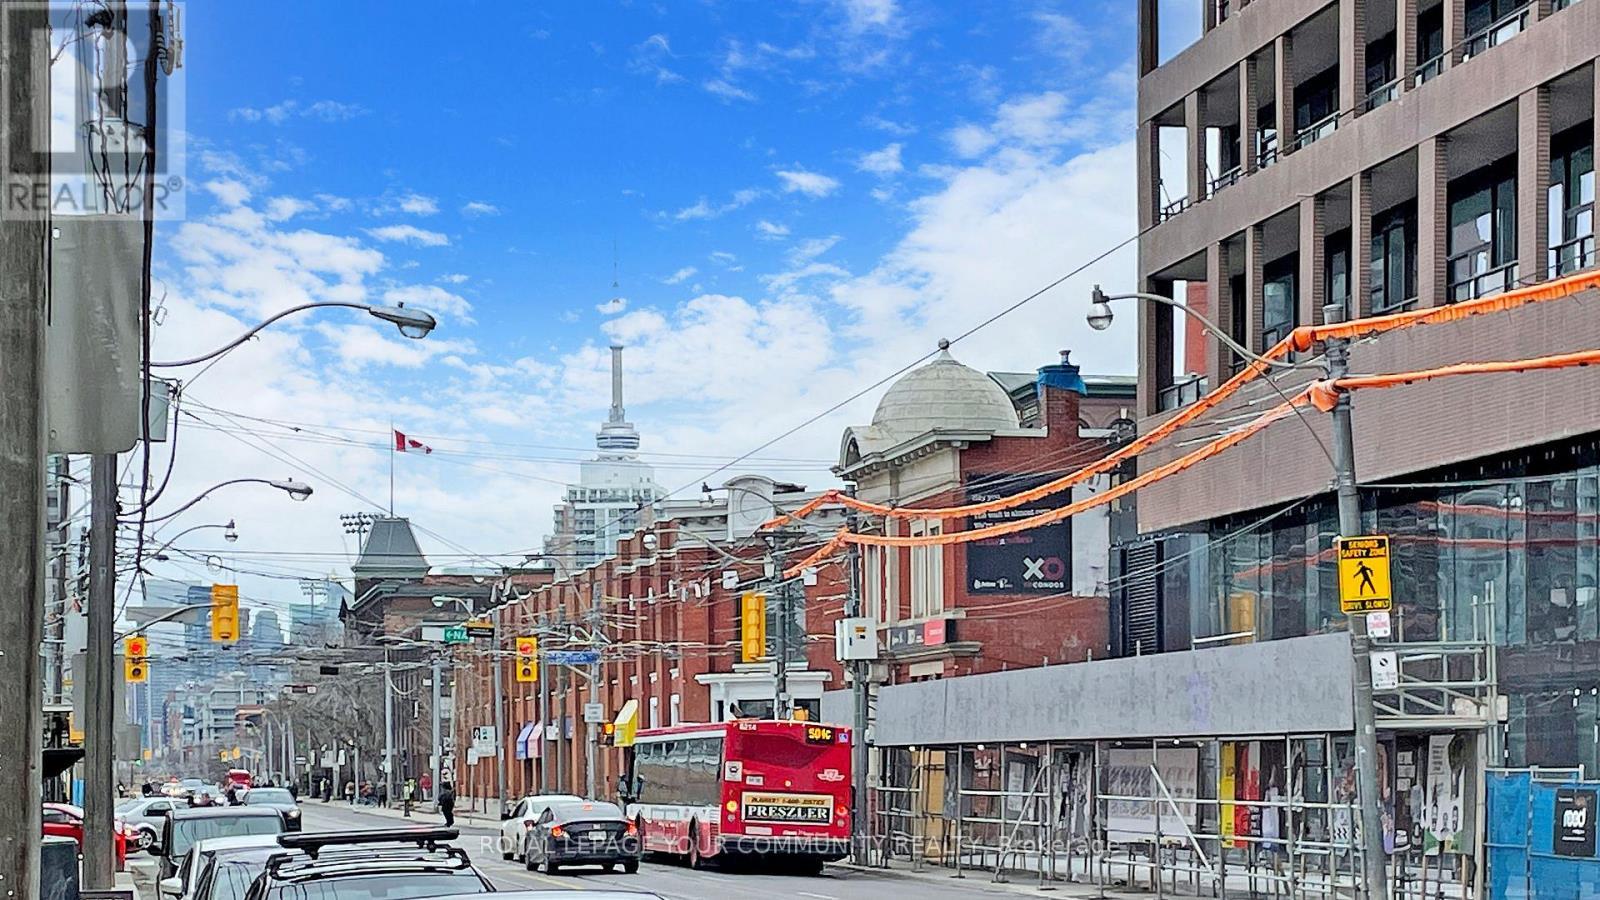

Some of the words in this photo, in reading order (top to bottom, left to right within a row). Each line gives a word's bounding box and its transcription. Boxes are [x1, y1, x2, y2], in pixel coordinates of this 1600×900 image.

[1348, 540, 1379, 549] SENIORS
[1341, 549, 1367, 557] SAFETY
[1369, 547, 1386, 556] ZONE
[1022, 556, 1065, 580] XO
[1032, 581, 1065, 589] CONDOS
[1343, 601, 1363, 610] DRIVE
[1365, 600, 1389, 609] SLOWLY
[747, 805, 828, 818] PRESZLER
